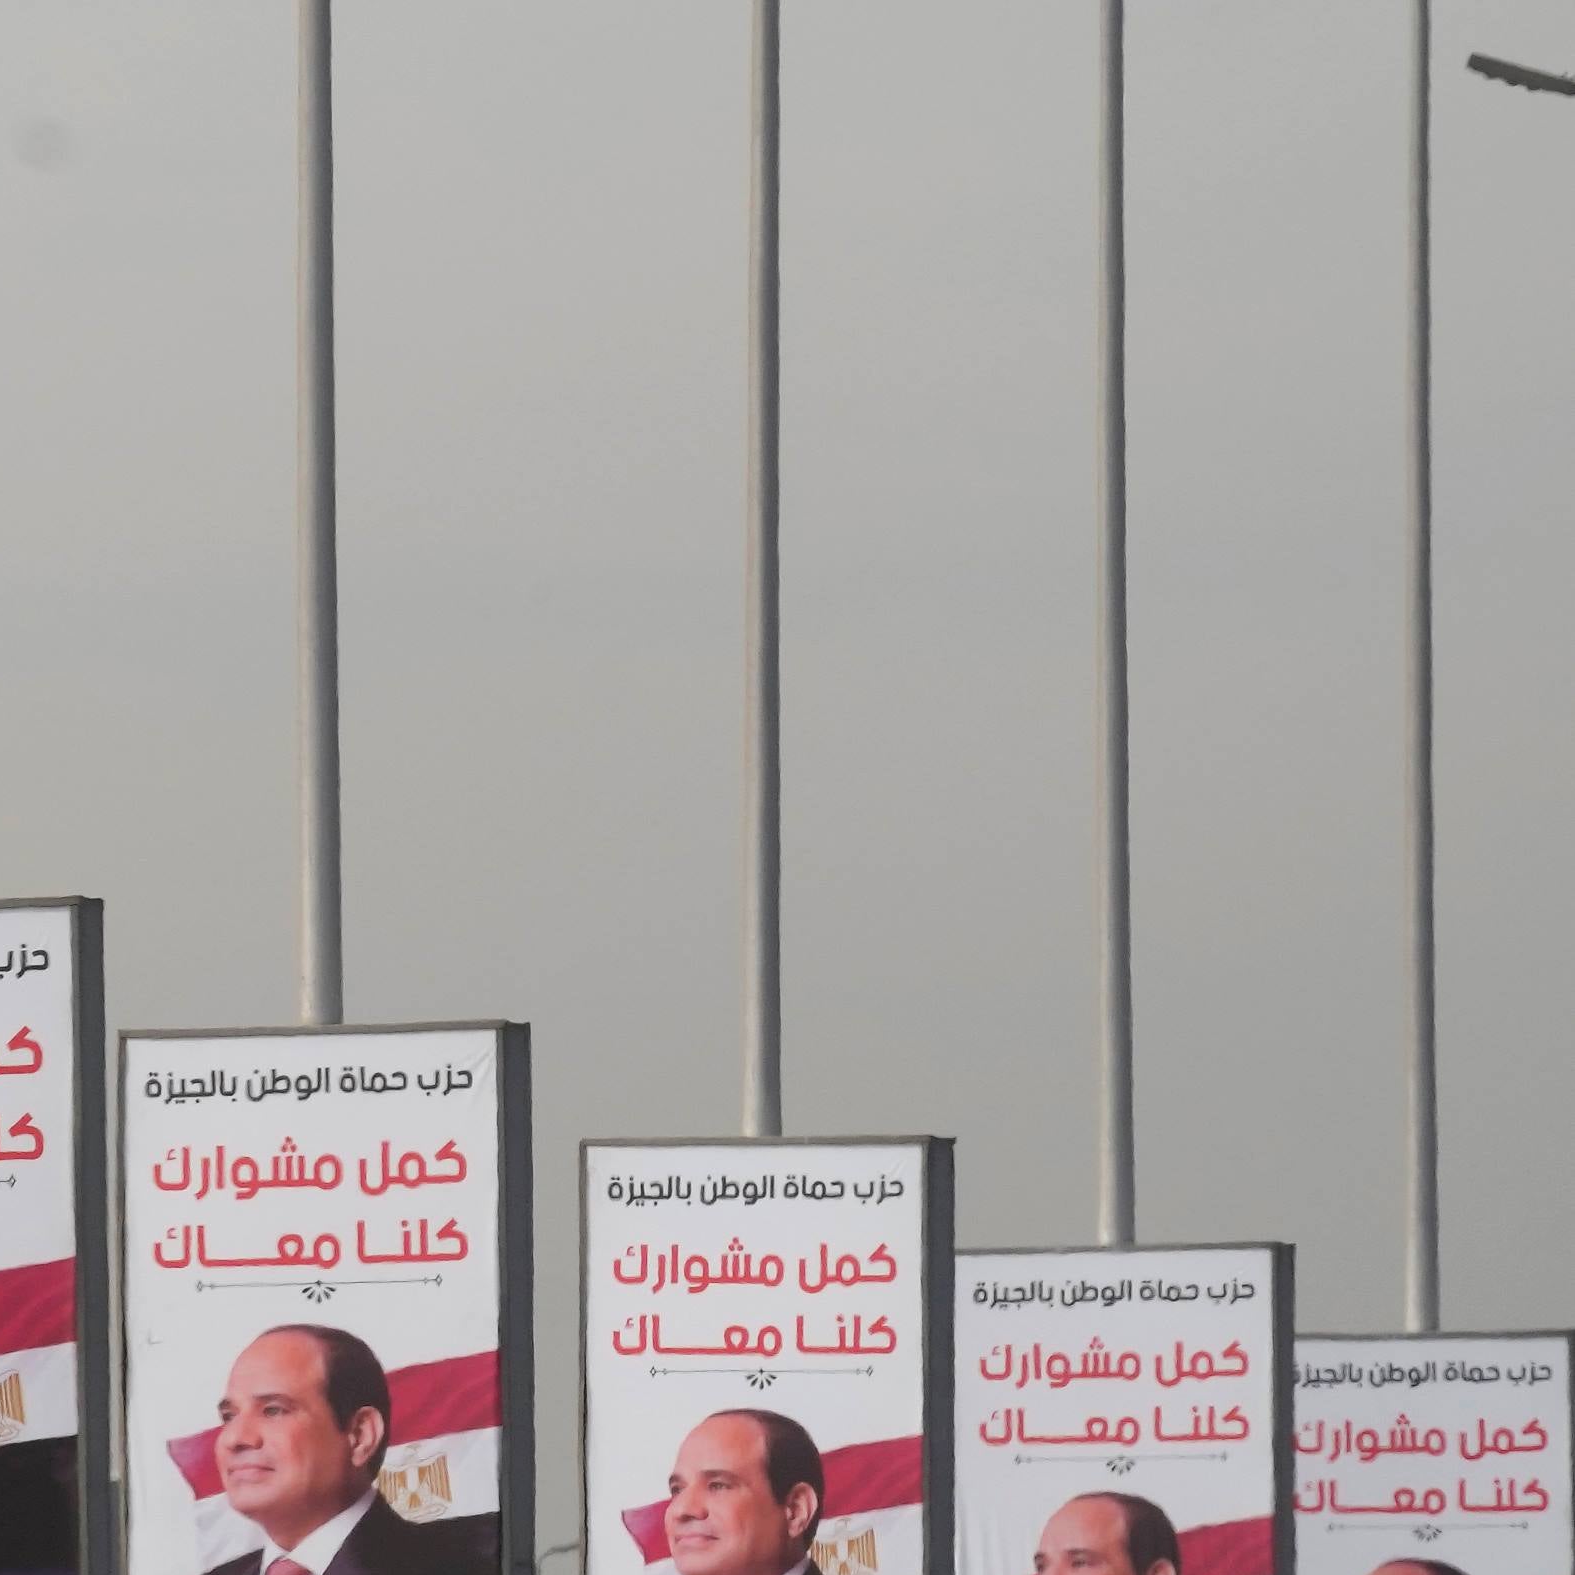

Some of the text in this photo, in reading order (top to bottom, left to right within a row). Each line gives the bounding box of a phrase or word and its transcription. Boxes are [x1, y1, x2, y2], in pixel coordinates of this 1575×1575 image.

[145, 1064, 471, 1105] حزب حماة الوطن بالجيزة
[153, 1136, 466, 1202] كمل مشوارك
[608, 1175, 903, 1206] حزب حماة الوطن بالجيزة
[154, 1217, 468, 1269] كلنا معاك
[613, 1237, 897, 1295] كمل مشوارك
[973, 1278, 1254, 1309] حزب حماة الوطن بالجيزة
[612, 1314, 897, 1358] كلنا معاك
[979, 1336, 1248, 1390] كمل مشوارك
[979, 1405, 1250, 1446] كلنا معاك
